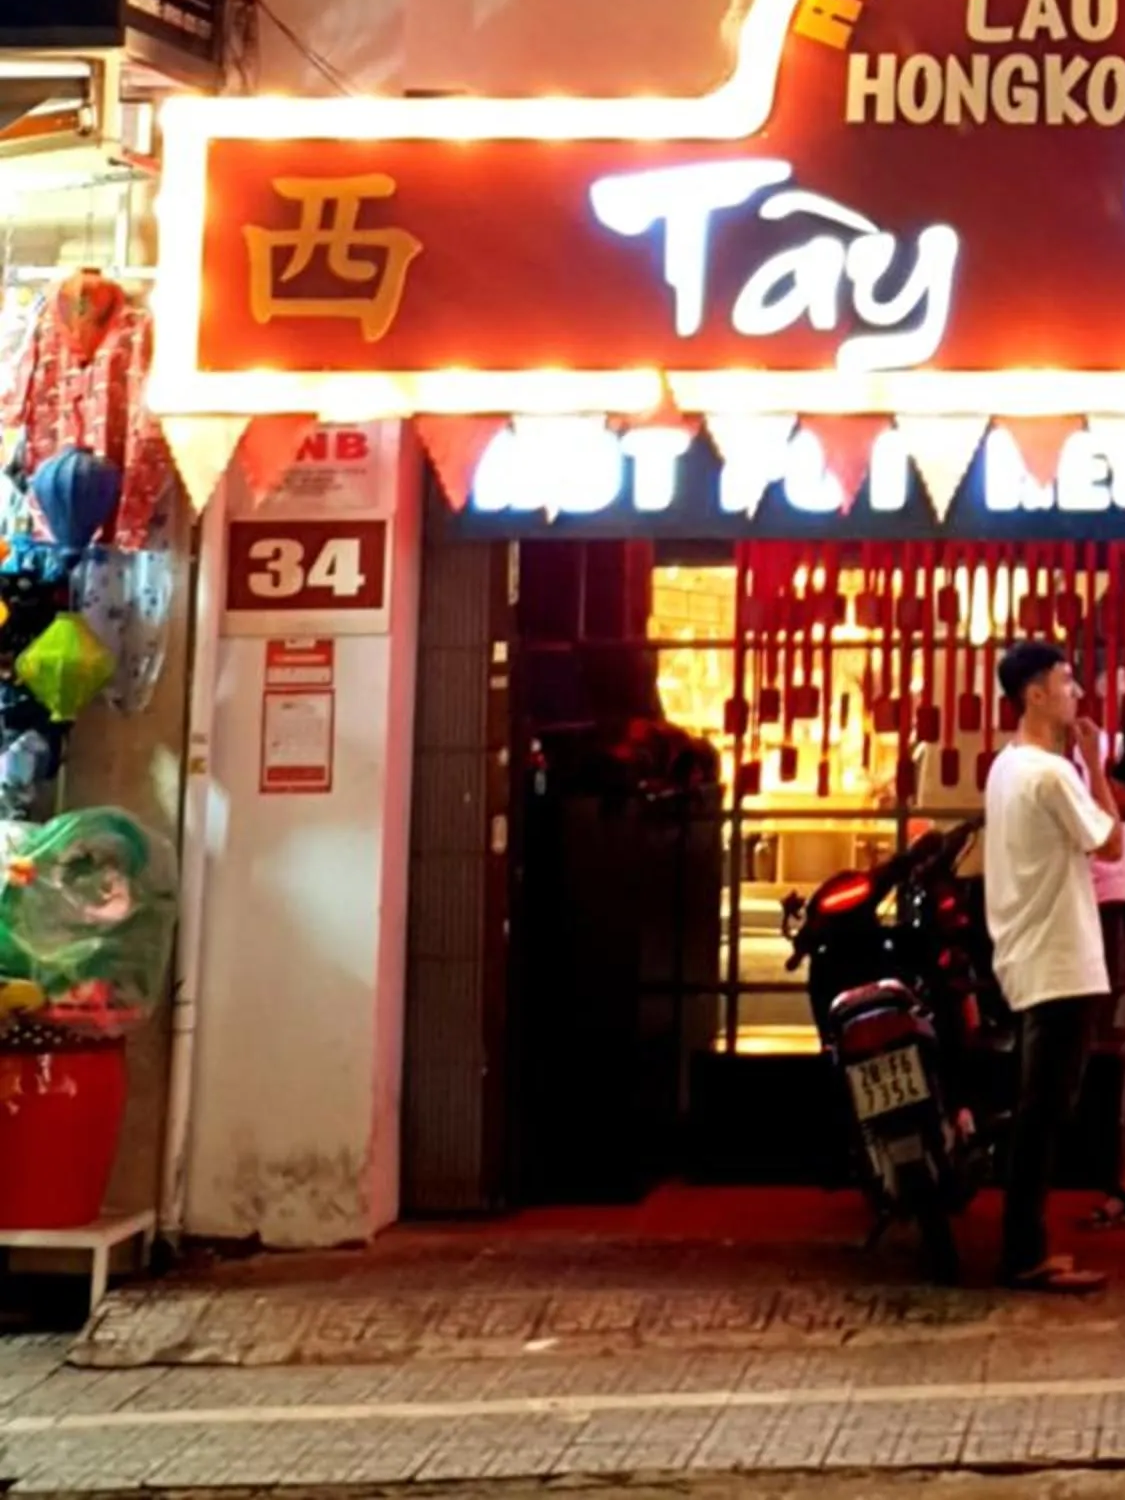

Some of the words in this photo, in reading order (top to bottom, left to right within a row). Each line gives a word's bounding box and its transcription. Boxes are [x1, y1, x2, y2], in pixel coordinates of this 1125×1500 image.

[243, 173, 423, 344] 西
[589, 159, 959, 374] Tây
[247, 537, 366, 597] 34
